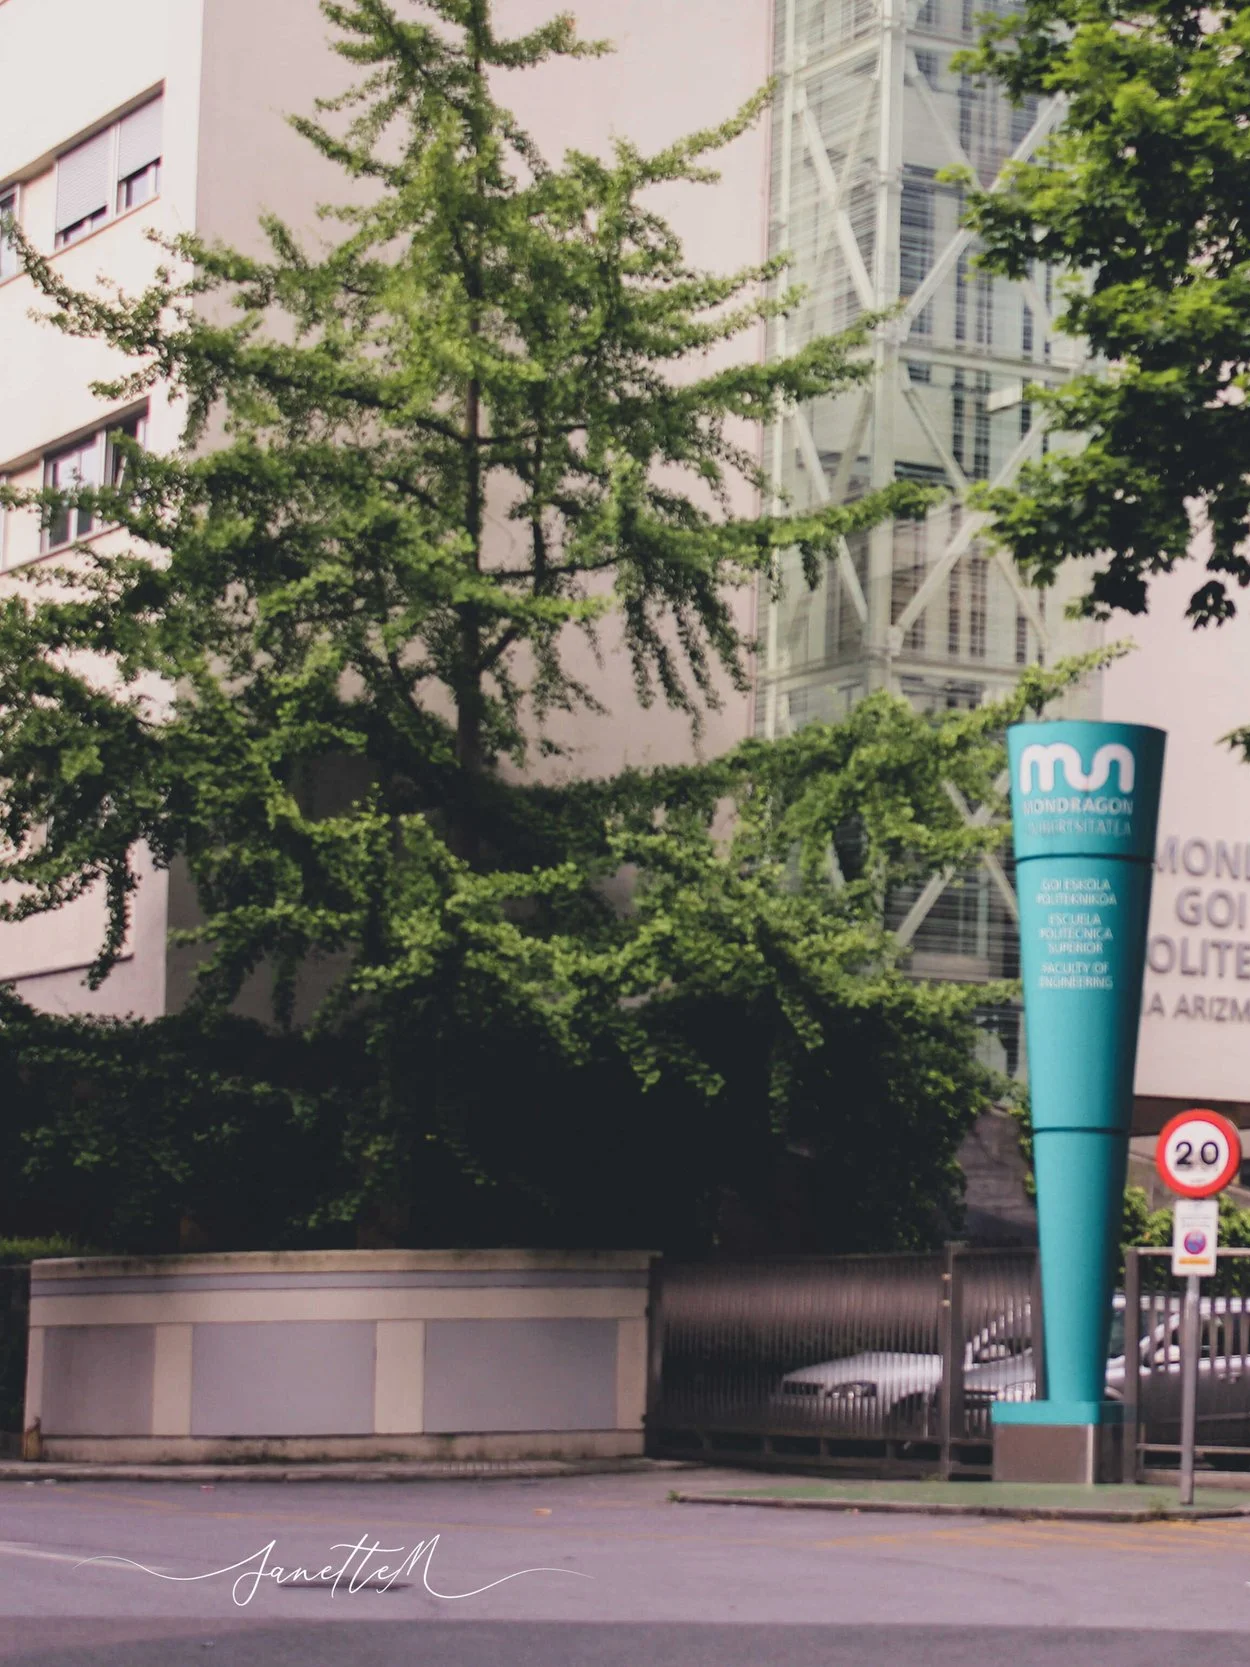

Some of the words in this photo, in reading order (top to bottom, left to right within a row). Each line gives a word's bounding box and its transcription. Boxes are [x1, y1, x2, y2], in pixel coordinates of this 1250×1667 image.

[1024, 797, 1134, 816] MONDRAGON
[1174, 885, 1246, 930] GOI
[1175, 1140, 1219, 1166] 20
